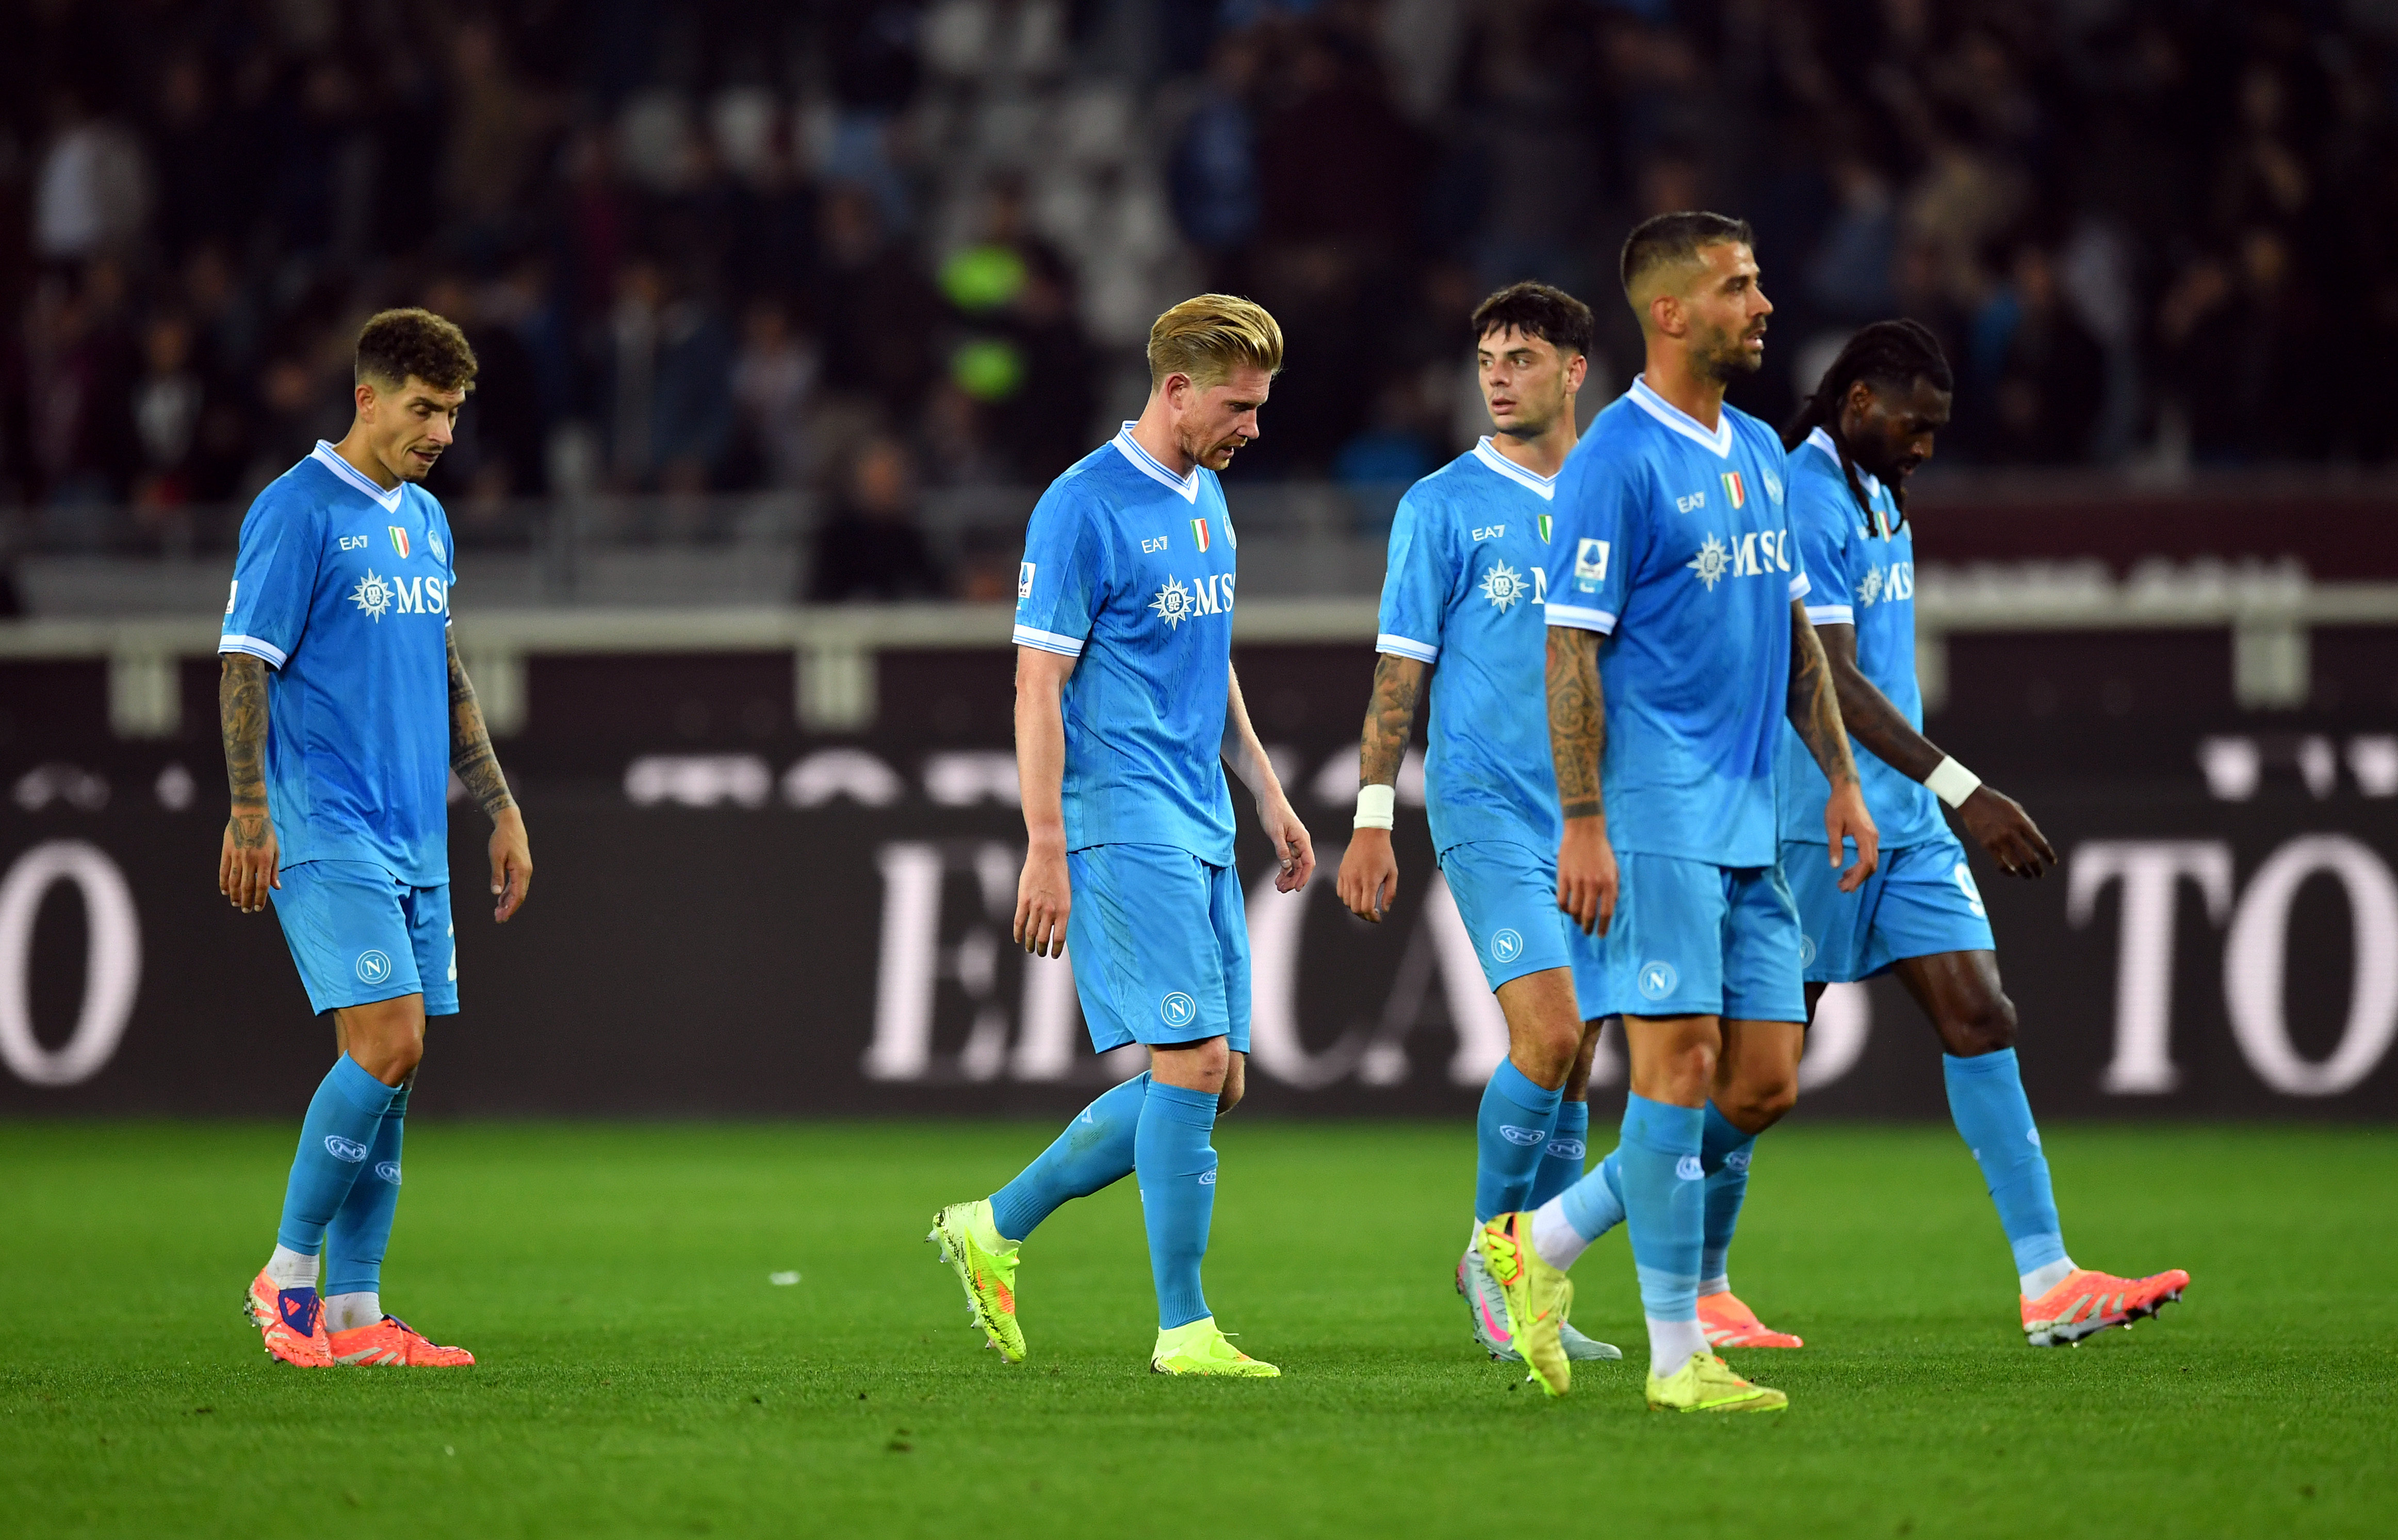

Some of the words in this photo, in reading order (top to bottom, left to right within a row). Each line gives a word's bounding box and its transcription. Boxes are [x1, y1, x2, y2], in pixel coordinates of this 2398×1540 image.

[1676, 491, 1705, 514] EA7
[1472, 524, 1506, 542] EA7
[339, 535, 368, 551] EA7
[1141, 535, 1168, 554] EA7
[1883, 561, 1913, 602] MS
[393, 576, 448, 614] MS
[1193, 572, 1236, 617] MS
[1498, 936, 1513, 955] N
[365, 958, 381, 976] N
[1650, 971, 1666, 990] N
[1169, 1001, 1185, 1018] N
